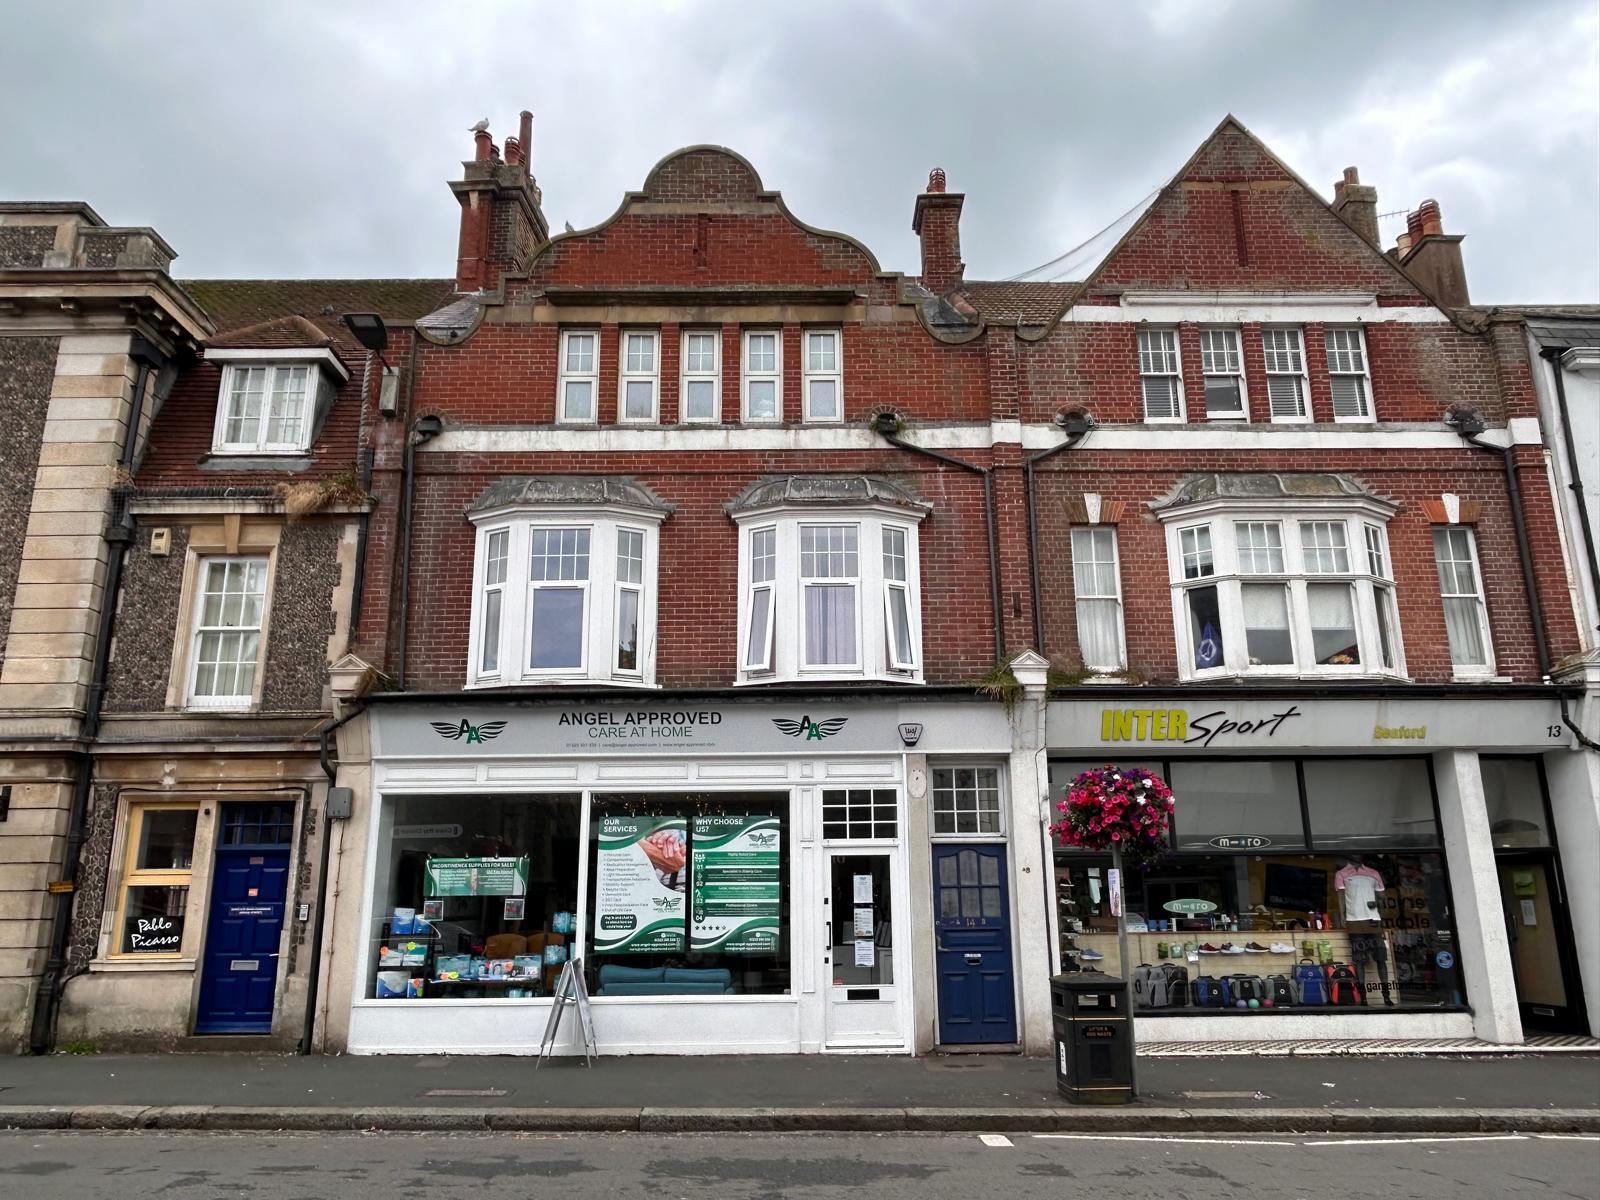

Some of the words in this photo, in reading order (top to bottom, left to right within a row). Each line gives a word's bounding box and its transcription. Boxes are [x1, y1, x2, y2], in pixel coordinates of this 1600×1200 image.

[558, 712, 620, 726] ANGEL
[624, 712, 722, 725] APPROVED
[588, 727, 627, 738] CARE
[630, 727, 647, 738] AT
[651, 726, 693, 738] HOME
[1100, 709, 1188, 742] INTER
[1184, 706, 1301, 748] Sport
[1374, 725, 1426, 740] Seaford
[1546, 725, 1562, 738] 13
[138, 917, 172, 933] Pablo
[131, 934, 179, 948] Picasso
